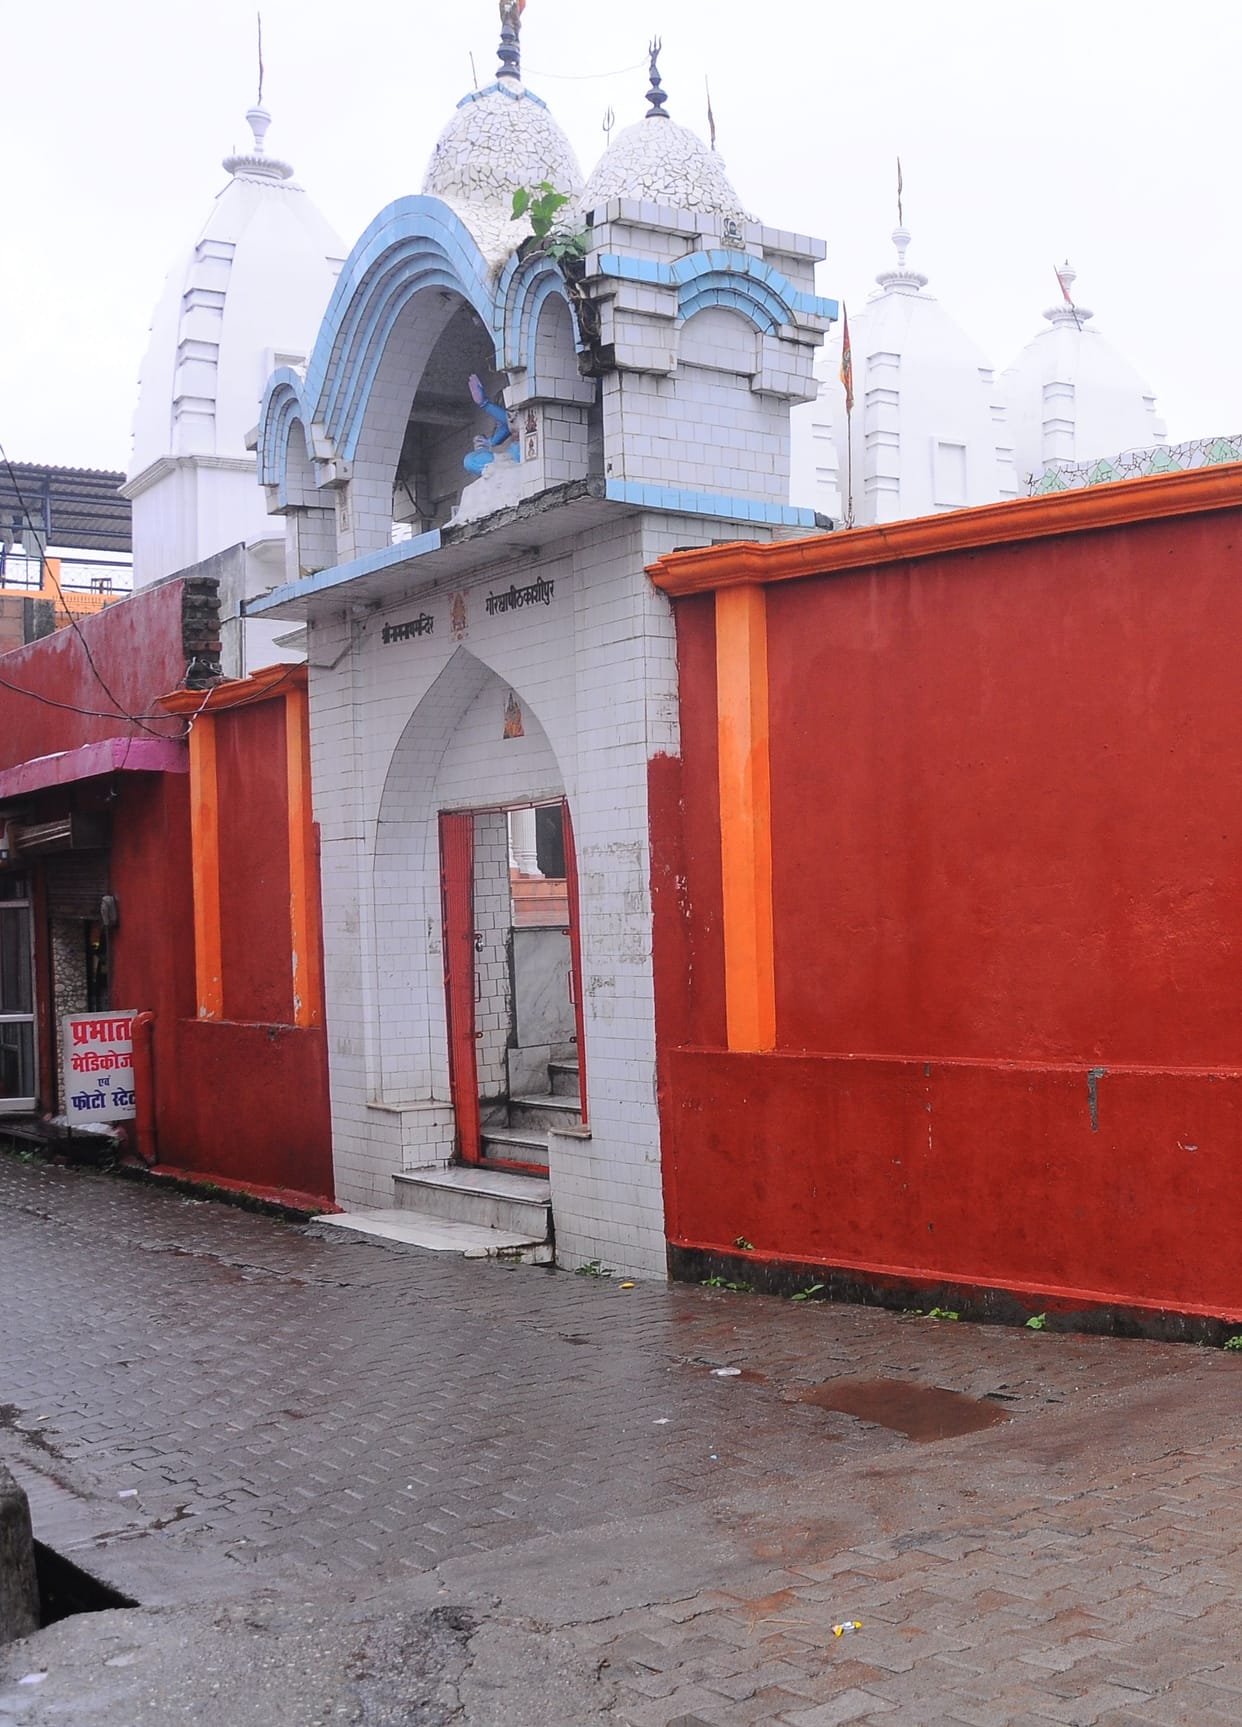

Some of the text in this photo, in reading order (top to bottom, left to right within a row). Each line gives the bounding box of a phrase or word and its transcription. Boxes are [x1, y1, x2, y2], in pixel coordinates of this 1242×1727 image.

[71, 1018, 132, 1046] प्रभात
[98, 1075, 111, 1087] एवं
[71, 1089, 106, 1111] फोटो
